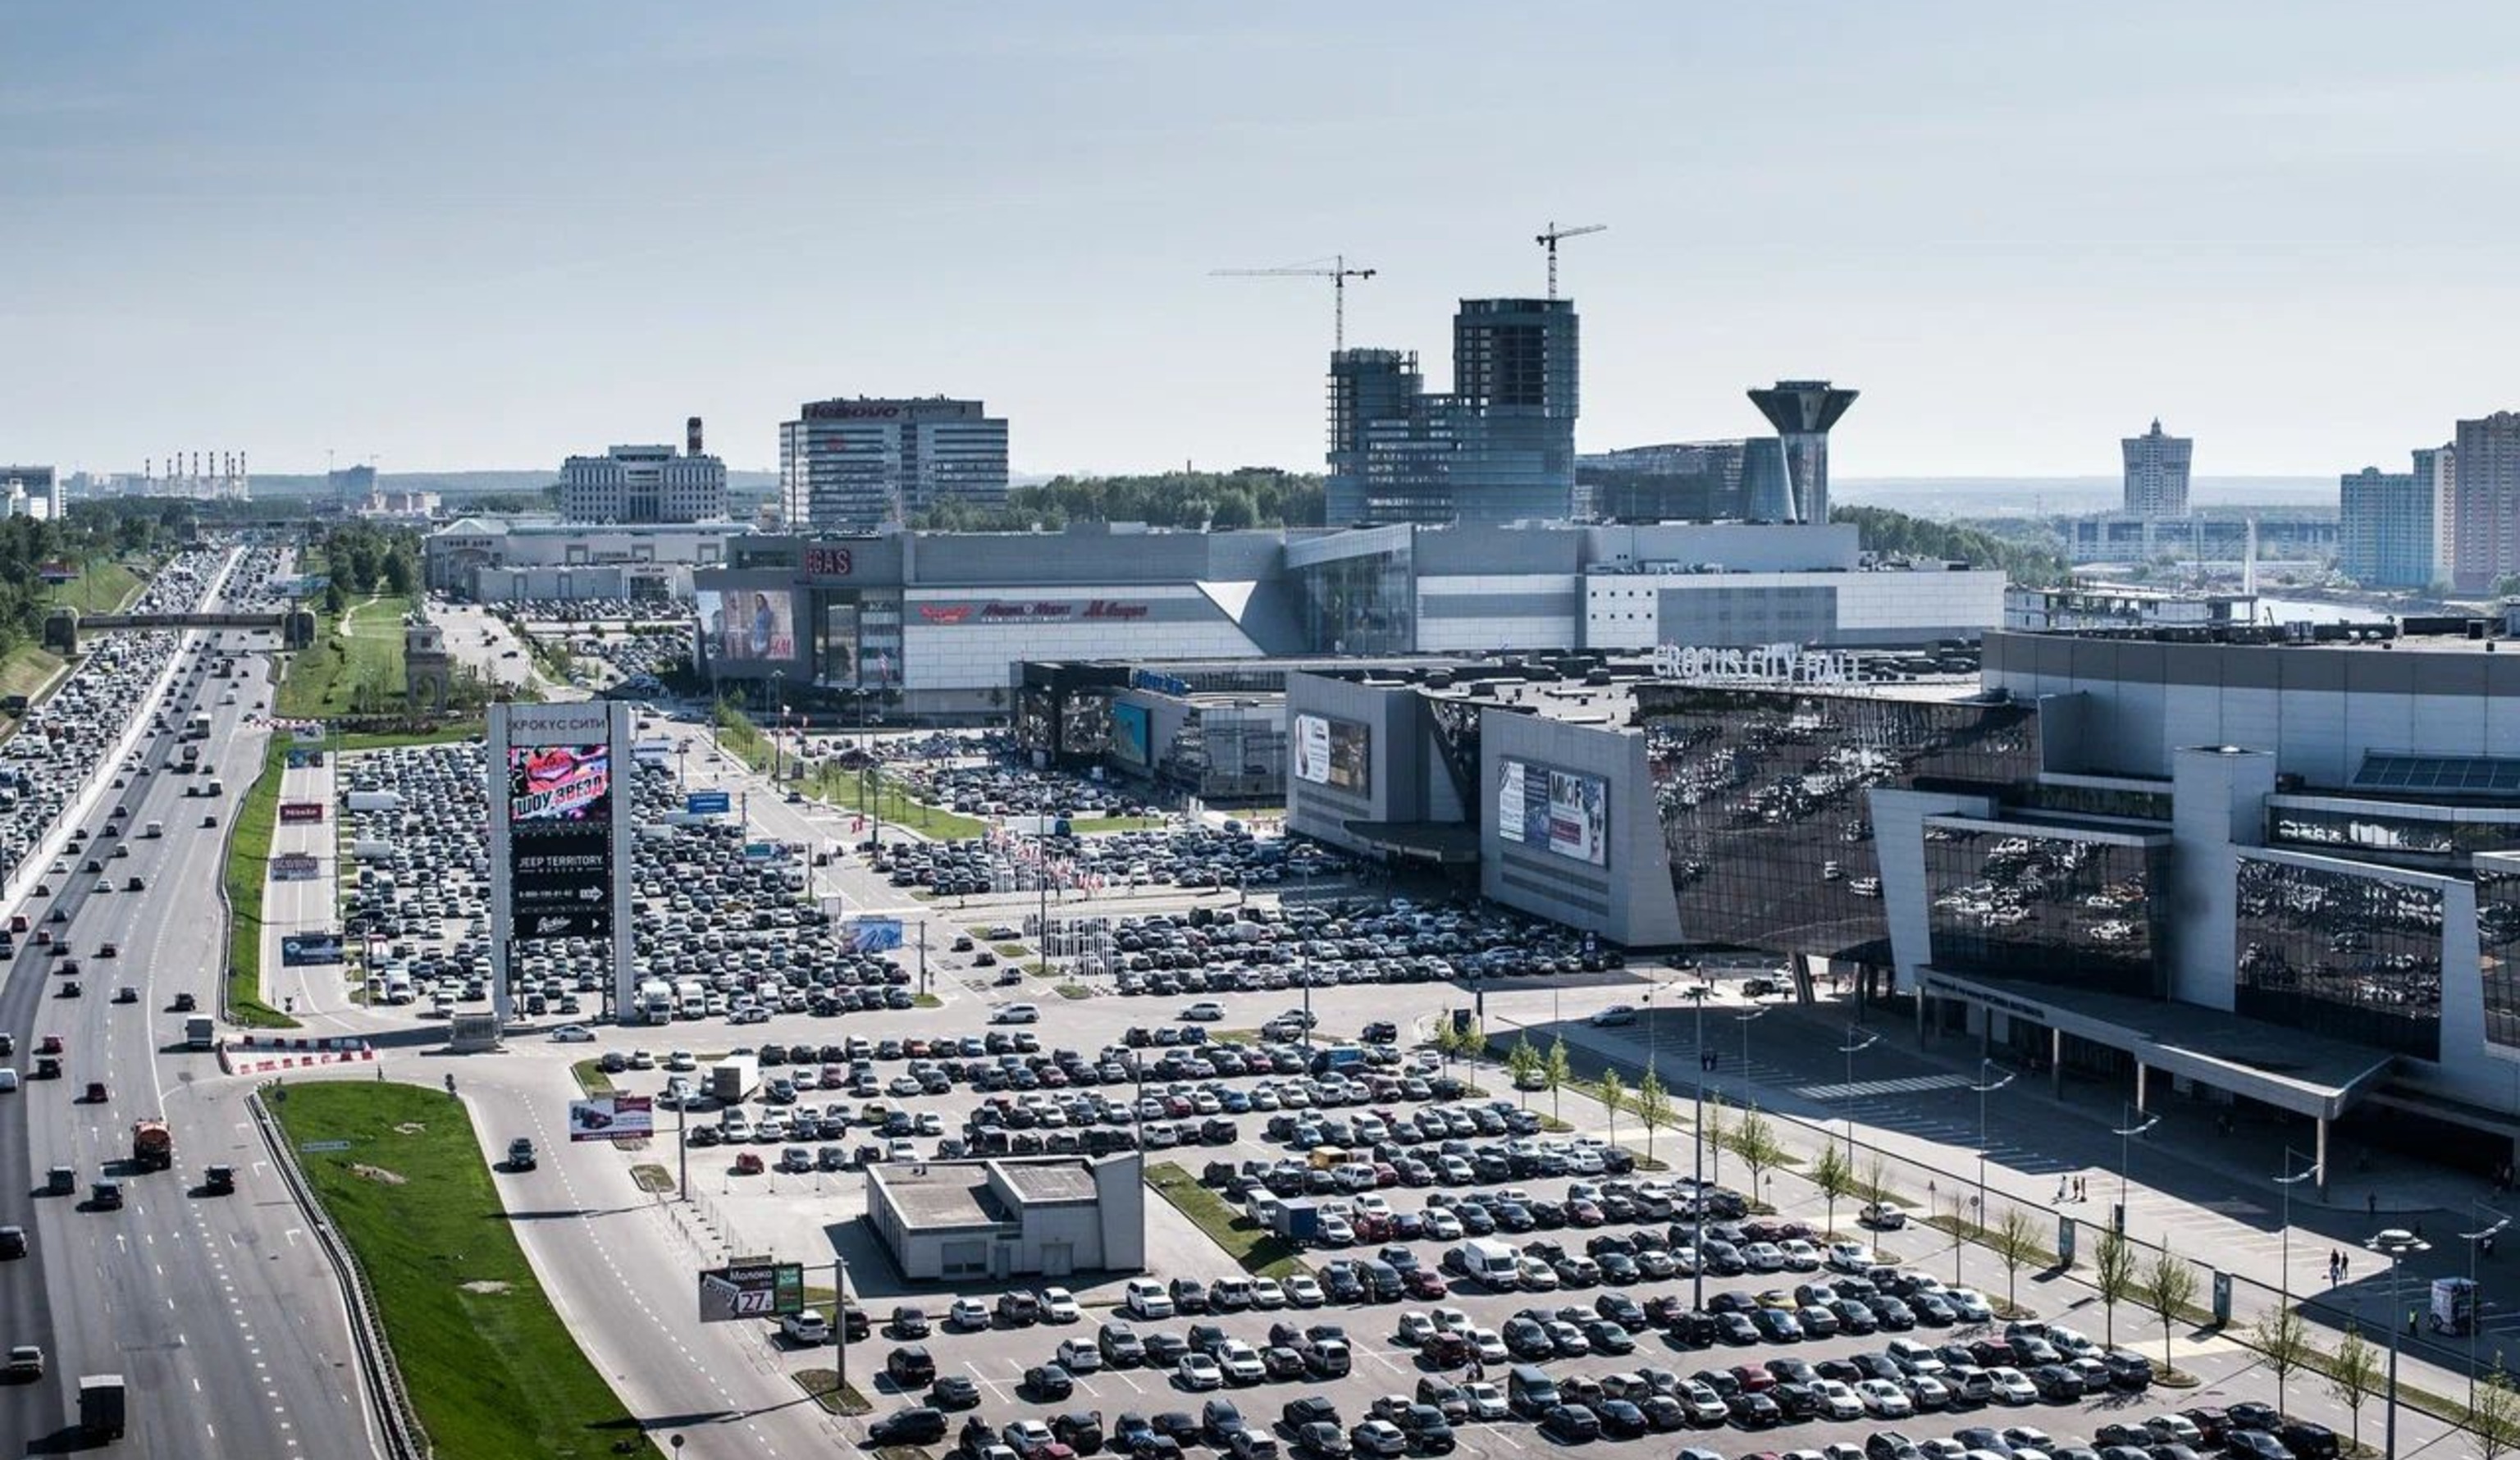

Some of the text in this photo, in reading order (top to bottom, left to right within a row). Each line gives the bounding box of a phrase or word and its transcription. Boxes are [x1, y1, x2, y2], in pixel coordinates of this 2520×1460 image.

[512, 719, 606, 731] КРОКУС СИТИ
[515, 774, 603, 814] ШОУ ЗВЕЗД
[518, 855, 604, 868] JEEP TERRITORY
[729, 1270, 772, 1280] Молоко
[742, 1292, 766, 1312] 27
